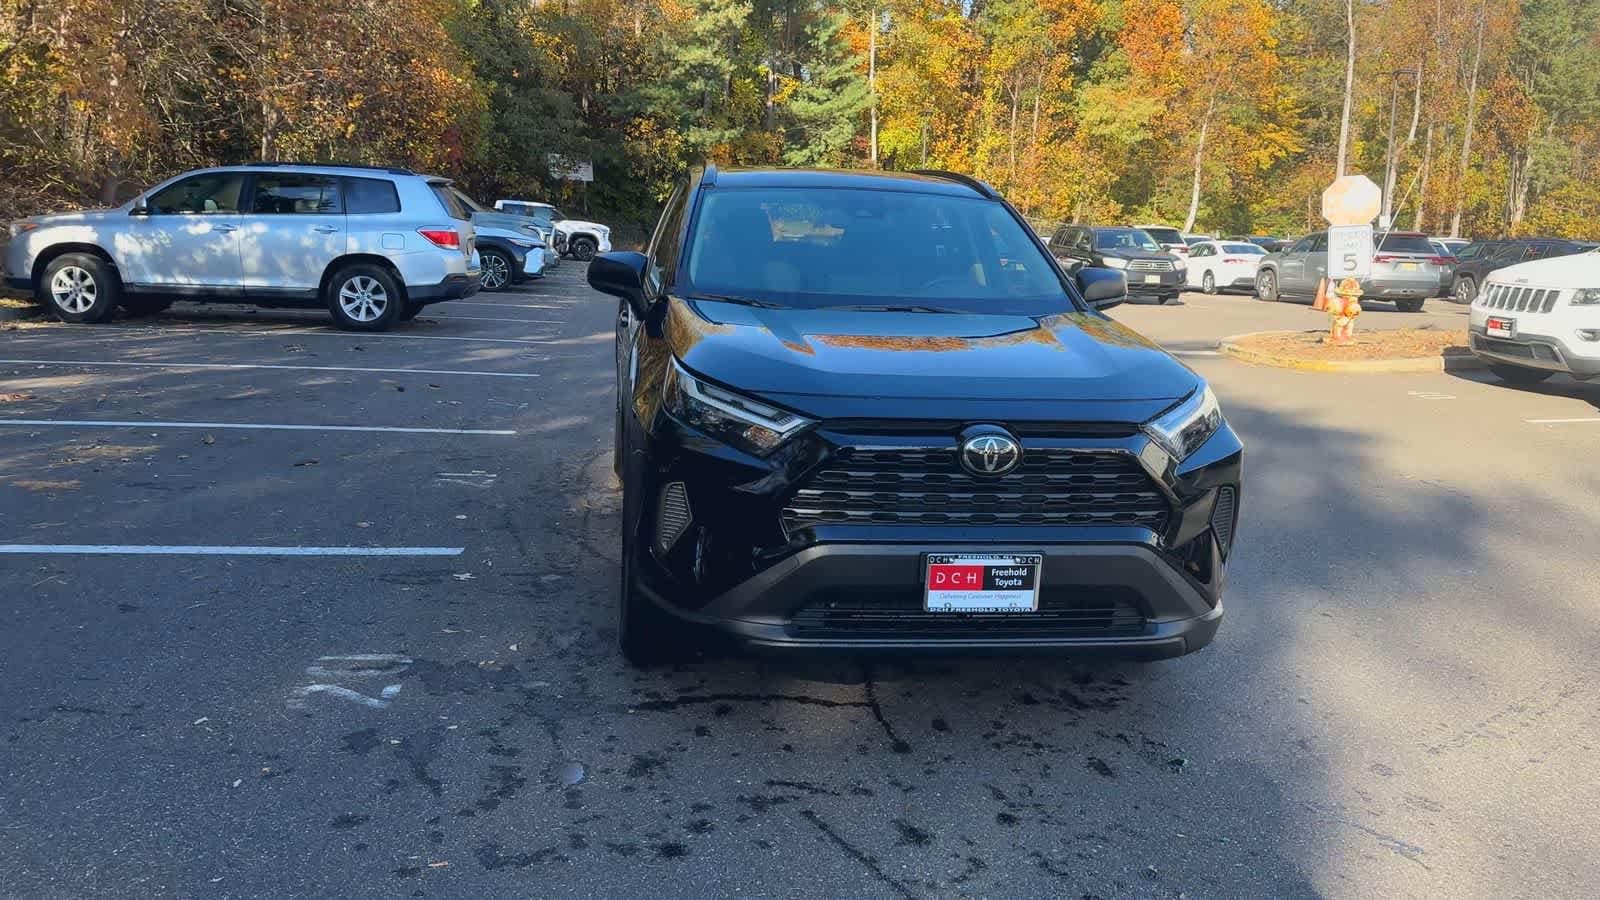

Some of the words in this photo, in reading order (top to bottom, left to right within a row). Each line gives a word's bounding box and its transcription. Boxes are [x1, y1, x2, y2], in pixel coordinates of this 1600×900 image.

[1343, 253, 1358, 272] 5
[991, 568, 1028, 577] Freehold
[995, 578, 1023, 588] Toyota
